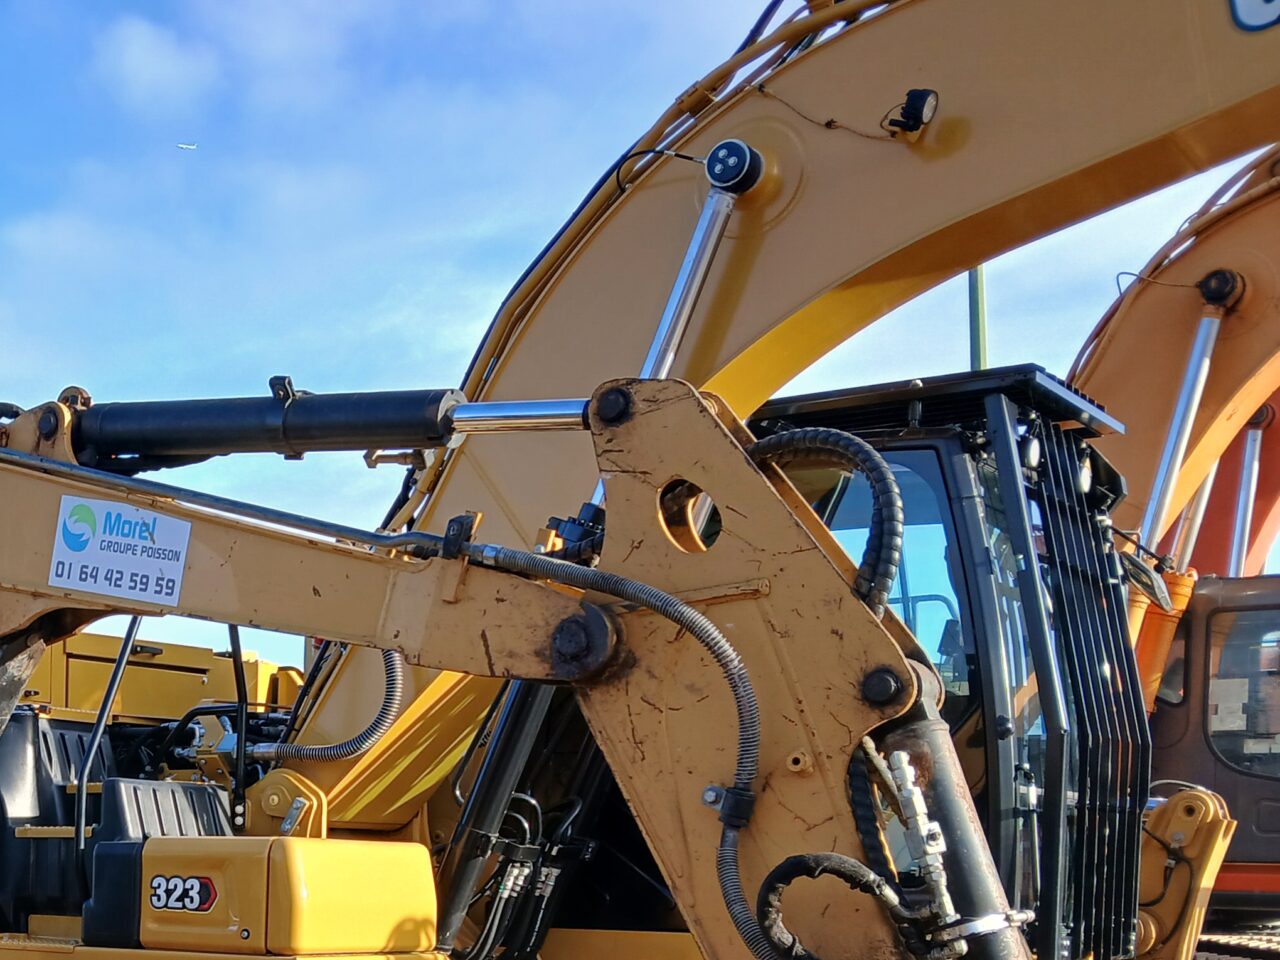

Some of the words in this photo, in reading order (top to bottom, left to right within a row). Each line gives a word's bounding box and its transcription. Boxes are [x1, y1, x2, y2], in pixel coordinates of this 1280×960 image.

[102, 511, 157, 541] Morel
[99, 539, 138, 557] GROUPE
[140, 545, 181, 562] POISSON
[55, 560, 72, 580] 01
[78, 564, 99, 584] 64
[104, 568, 124, 588] 42
[128, 572, 150, 593] 59
[153, 576, 176, 597] 59
[150, 875, 201, 910] 323
